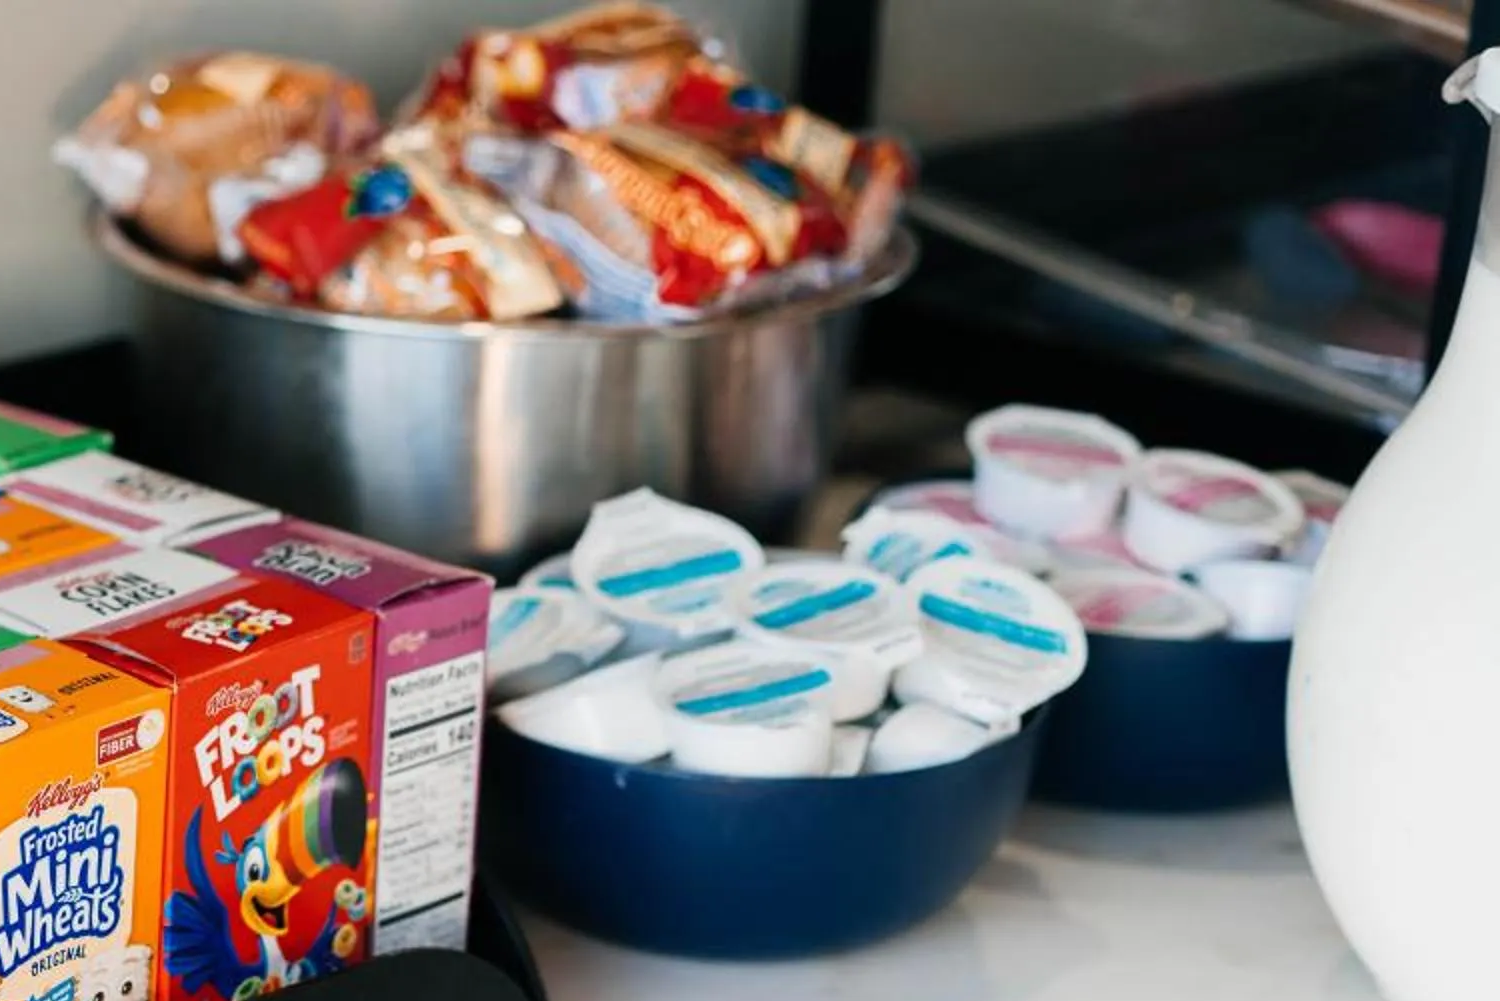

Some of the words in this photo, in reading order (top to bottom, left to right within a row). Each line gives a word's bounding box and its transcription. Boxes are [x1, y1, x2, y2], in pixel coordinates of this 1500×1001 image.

[61, 571, 149, 603] CORN
[85, 581, 177, 616] FLAKES
[57, 672, 121, 696] ORIGINAL
[194, 664, 322, 788] FROOT
[100, 734, 136, 760] FIBER
[210, 716, 326, 822] LOOPS
[27, 773, 102, 818] Kellogg's
[22, 808, 100, 858] Frosted
[6, 832, 115, 924] Mini
[31, 943, 87, 978] ORIGINAL
